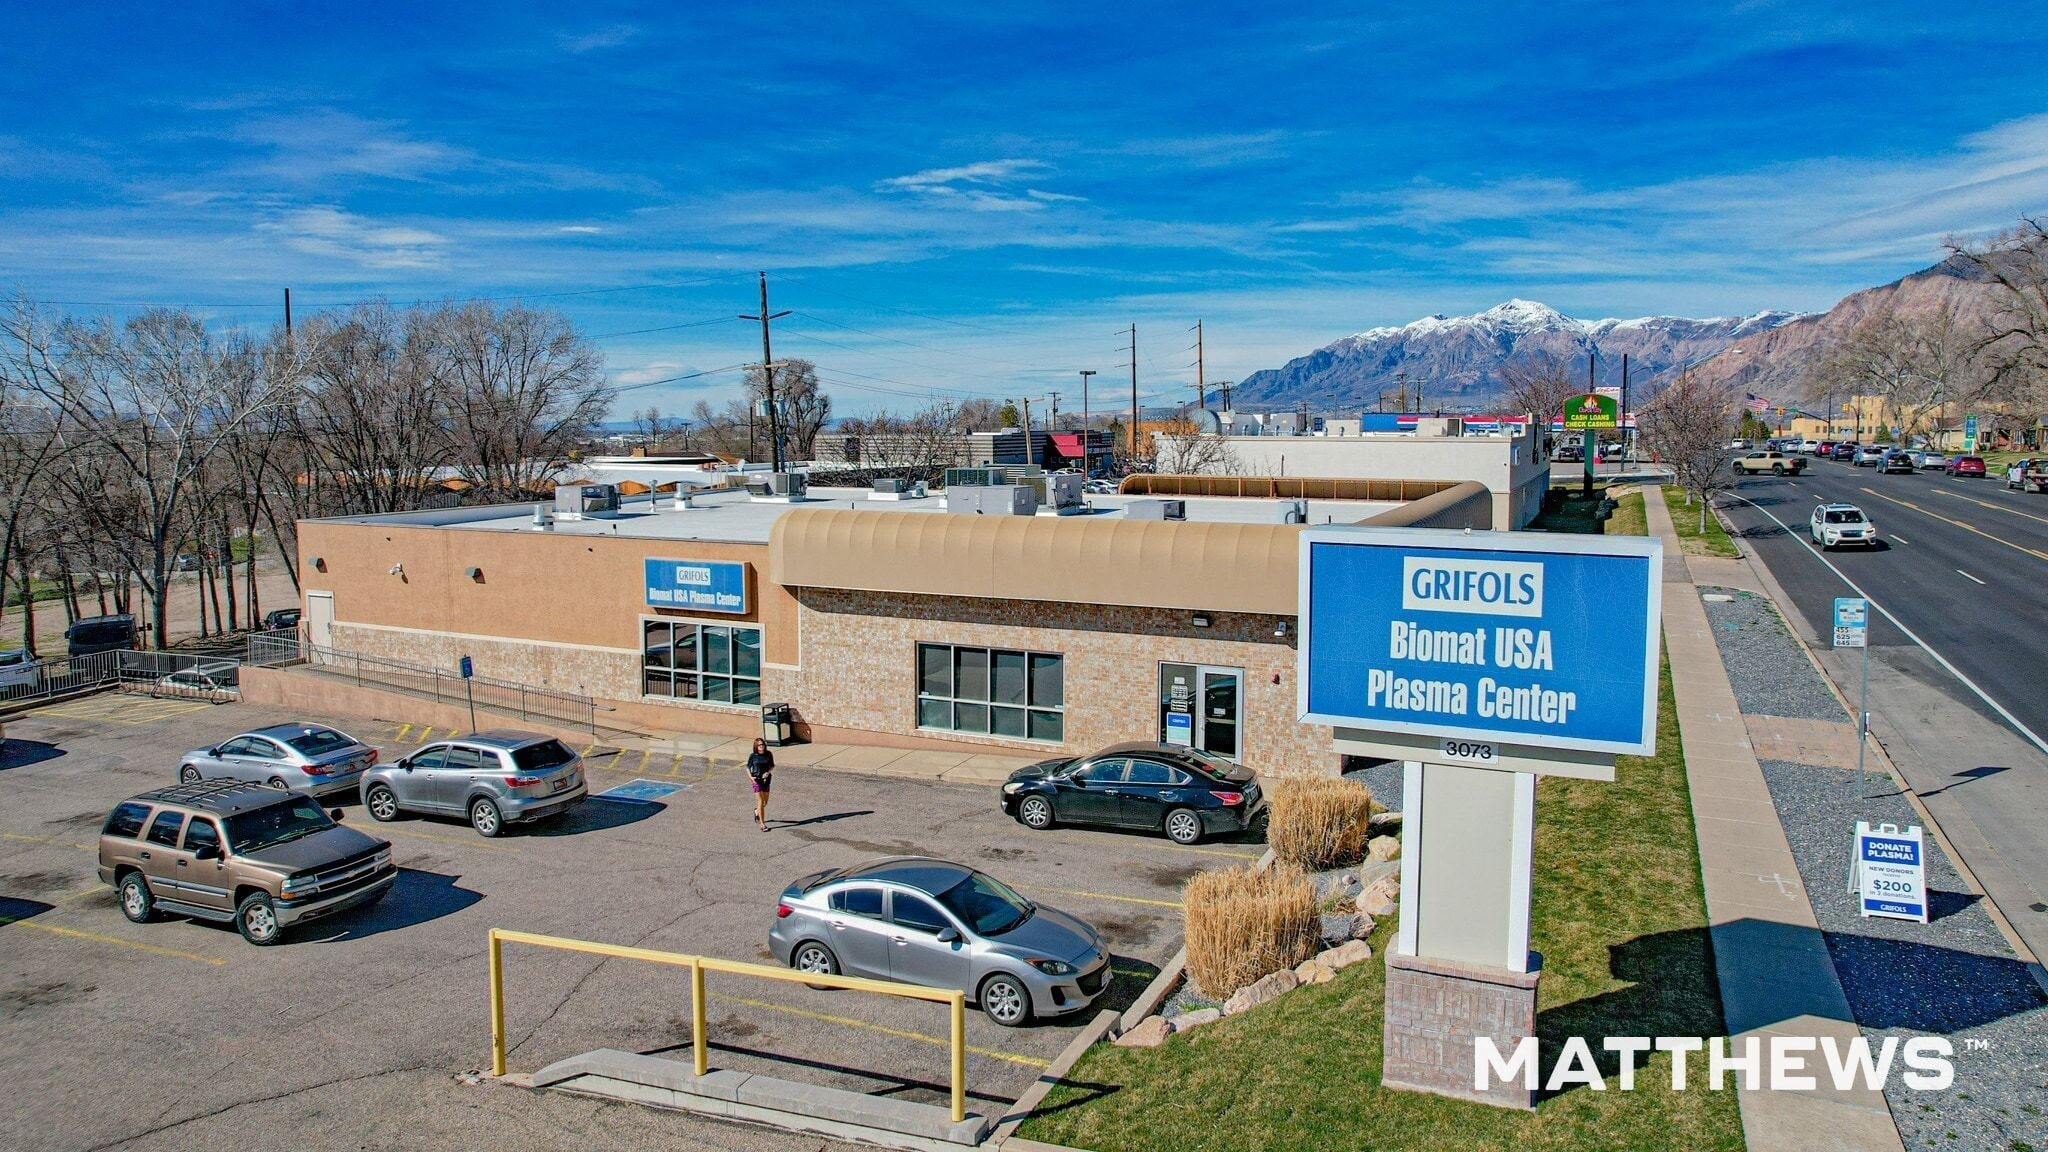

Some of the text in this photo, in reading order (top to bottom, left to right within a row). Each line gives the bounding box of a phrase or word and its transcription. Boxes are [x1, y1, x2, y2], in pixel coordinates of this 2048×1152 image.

[679, 570, 708, 581] GRIFOLS
[1412, 568, 1535, 605] GRIFOLS
[649, 588, 741, 606] Biomat USA Plasma Center
[1390, 620, 1553, 671] Biomat USA
[1367, 668, 1576, 724] Plasma Center
[1445, 741, 1493, 760] 3073
[1868, 850, 1914, 860] PLASMA!
[1869, 842, 1912, 852] DONATE
[1873, 879, 1912, 893] $200
[1880, 904, 1907, 912] GRIFOLS
